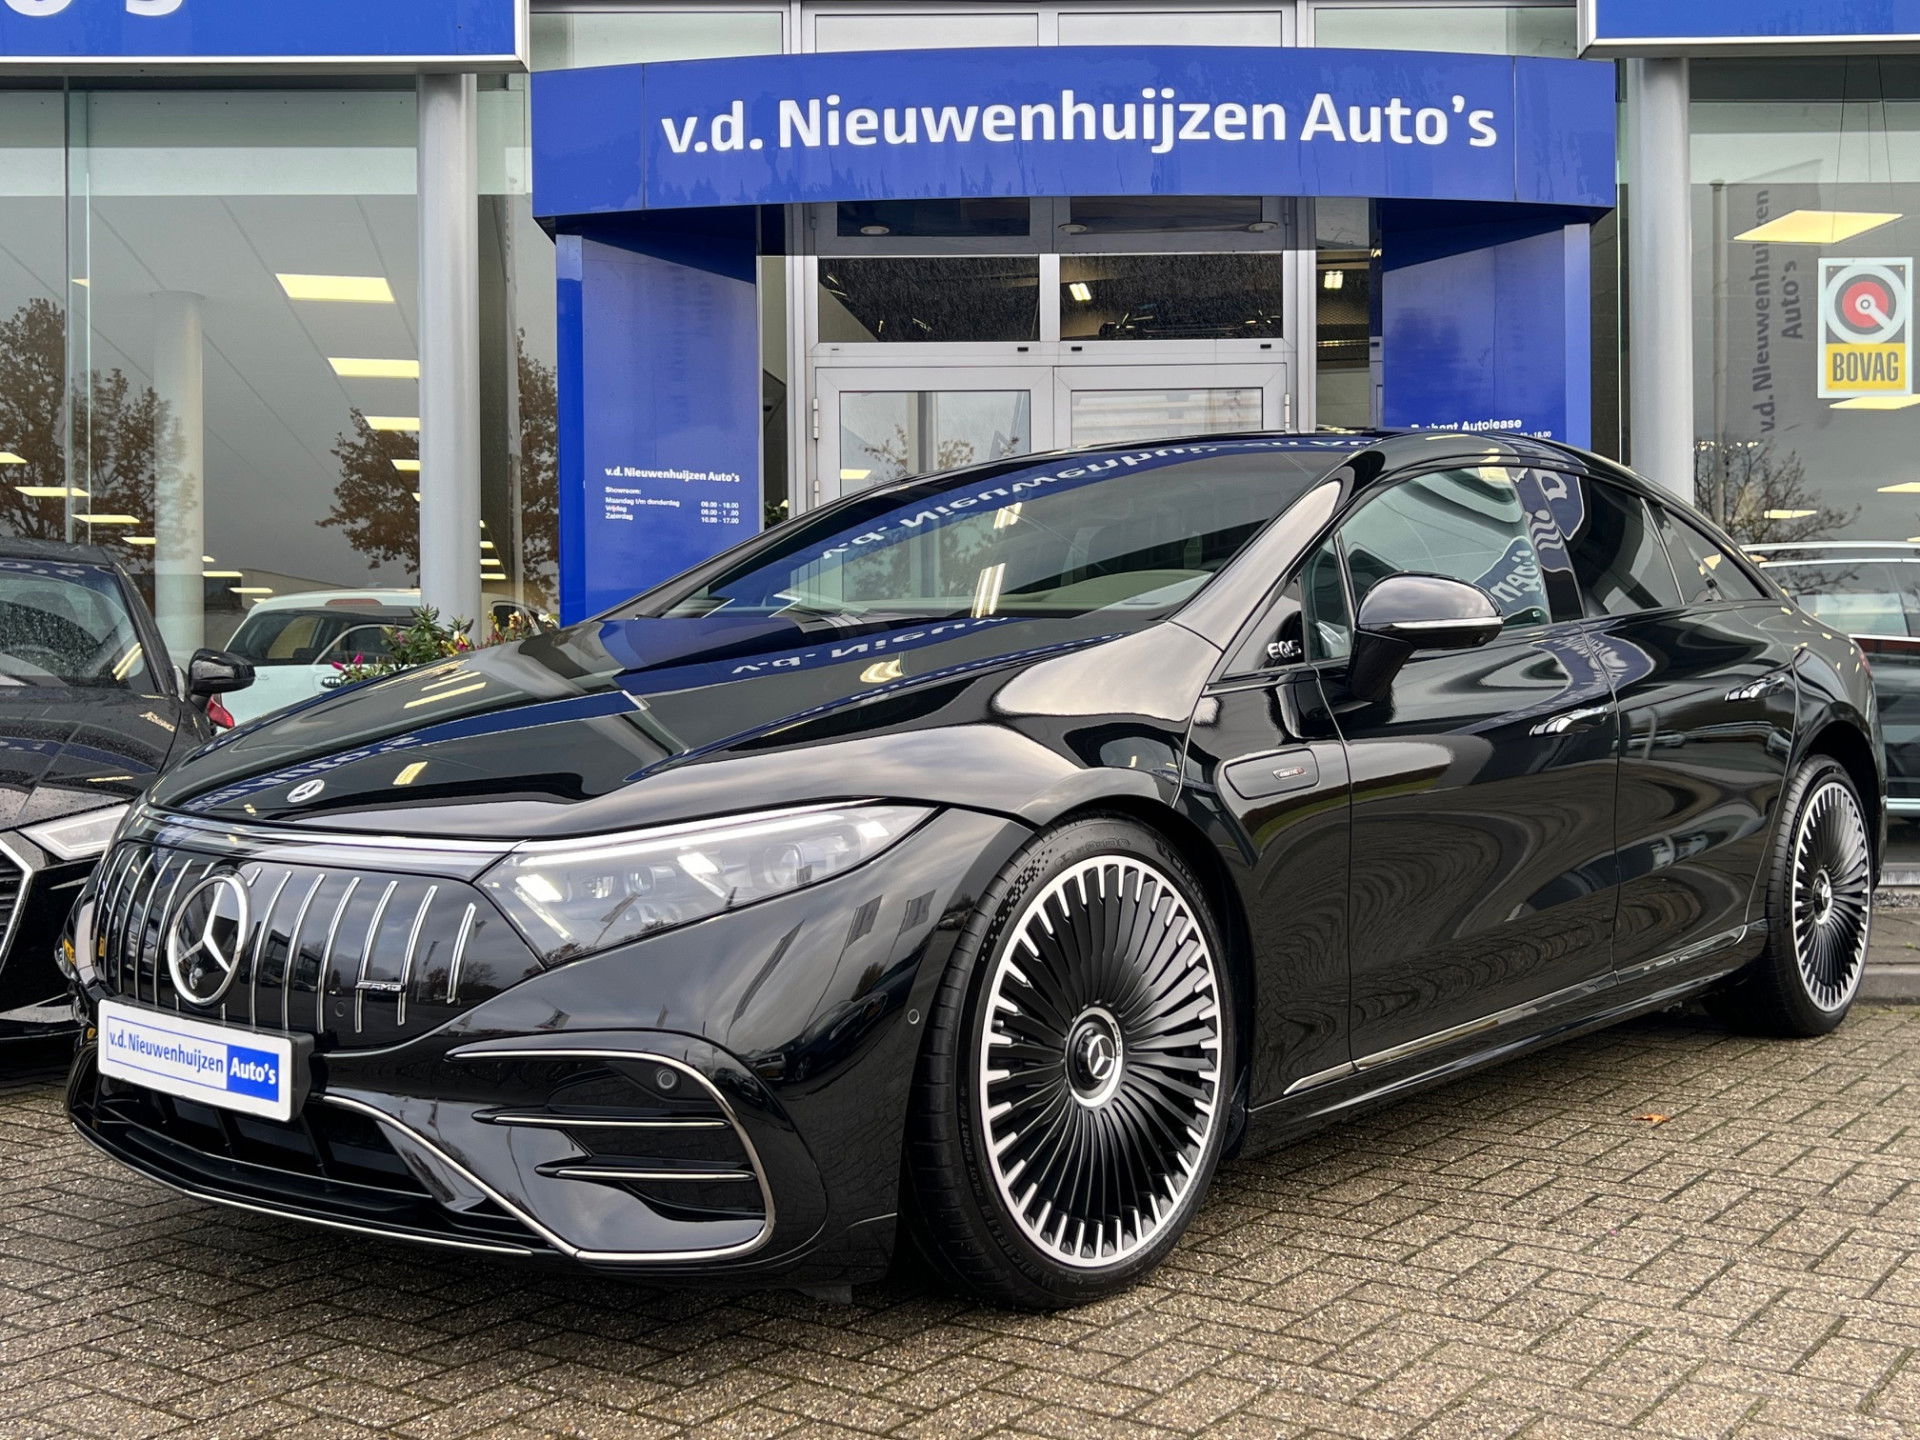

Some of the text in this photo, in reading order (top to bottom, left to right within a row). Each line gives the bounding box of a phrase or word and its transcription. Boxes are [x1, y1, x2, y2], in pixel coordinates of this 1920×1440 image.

[662, 87, 1498, 154] v.d. Nieuwenhuijzen Auto's
[1832, 351, 1899, 382] BOVAG
[1462, 418, 1522, 432] Autolease
[605, 466, 740, 483] v.d. Nieuwenhuijzen Auto's
[109, 1029, 277, 1086] v.d. Nieuwenhuijzen Auto's
